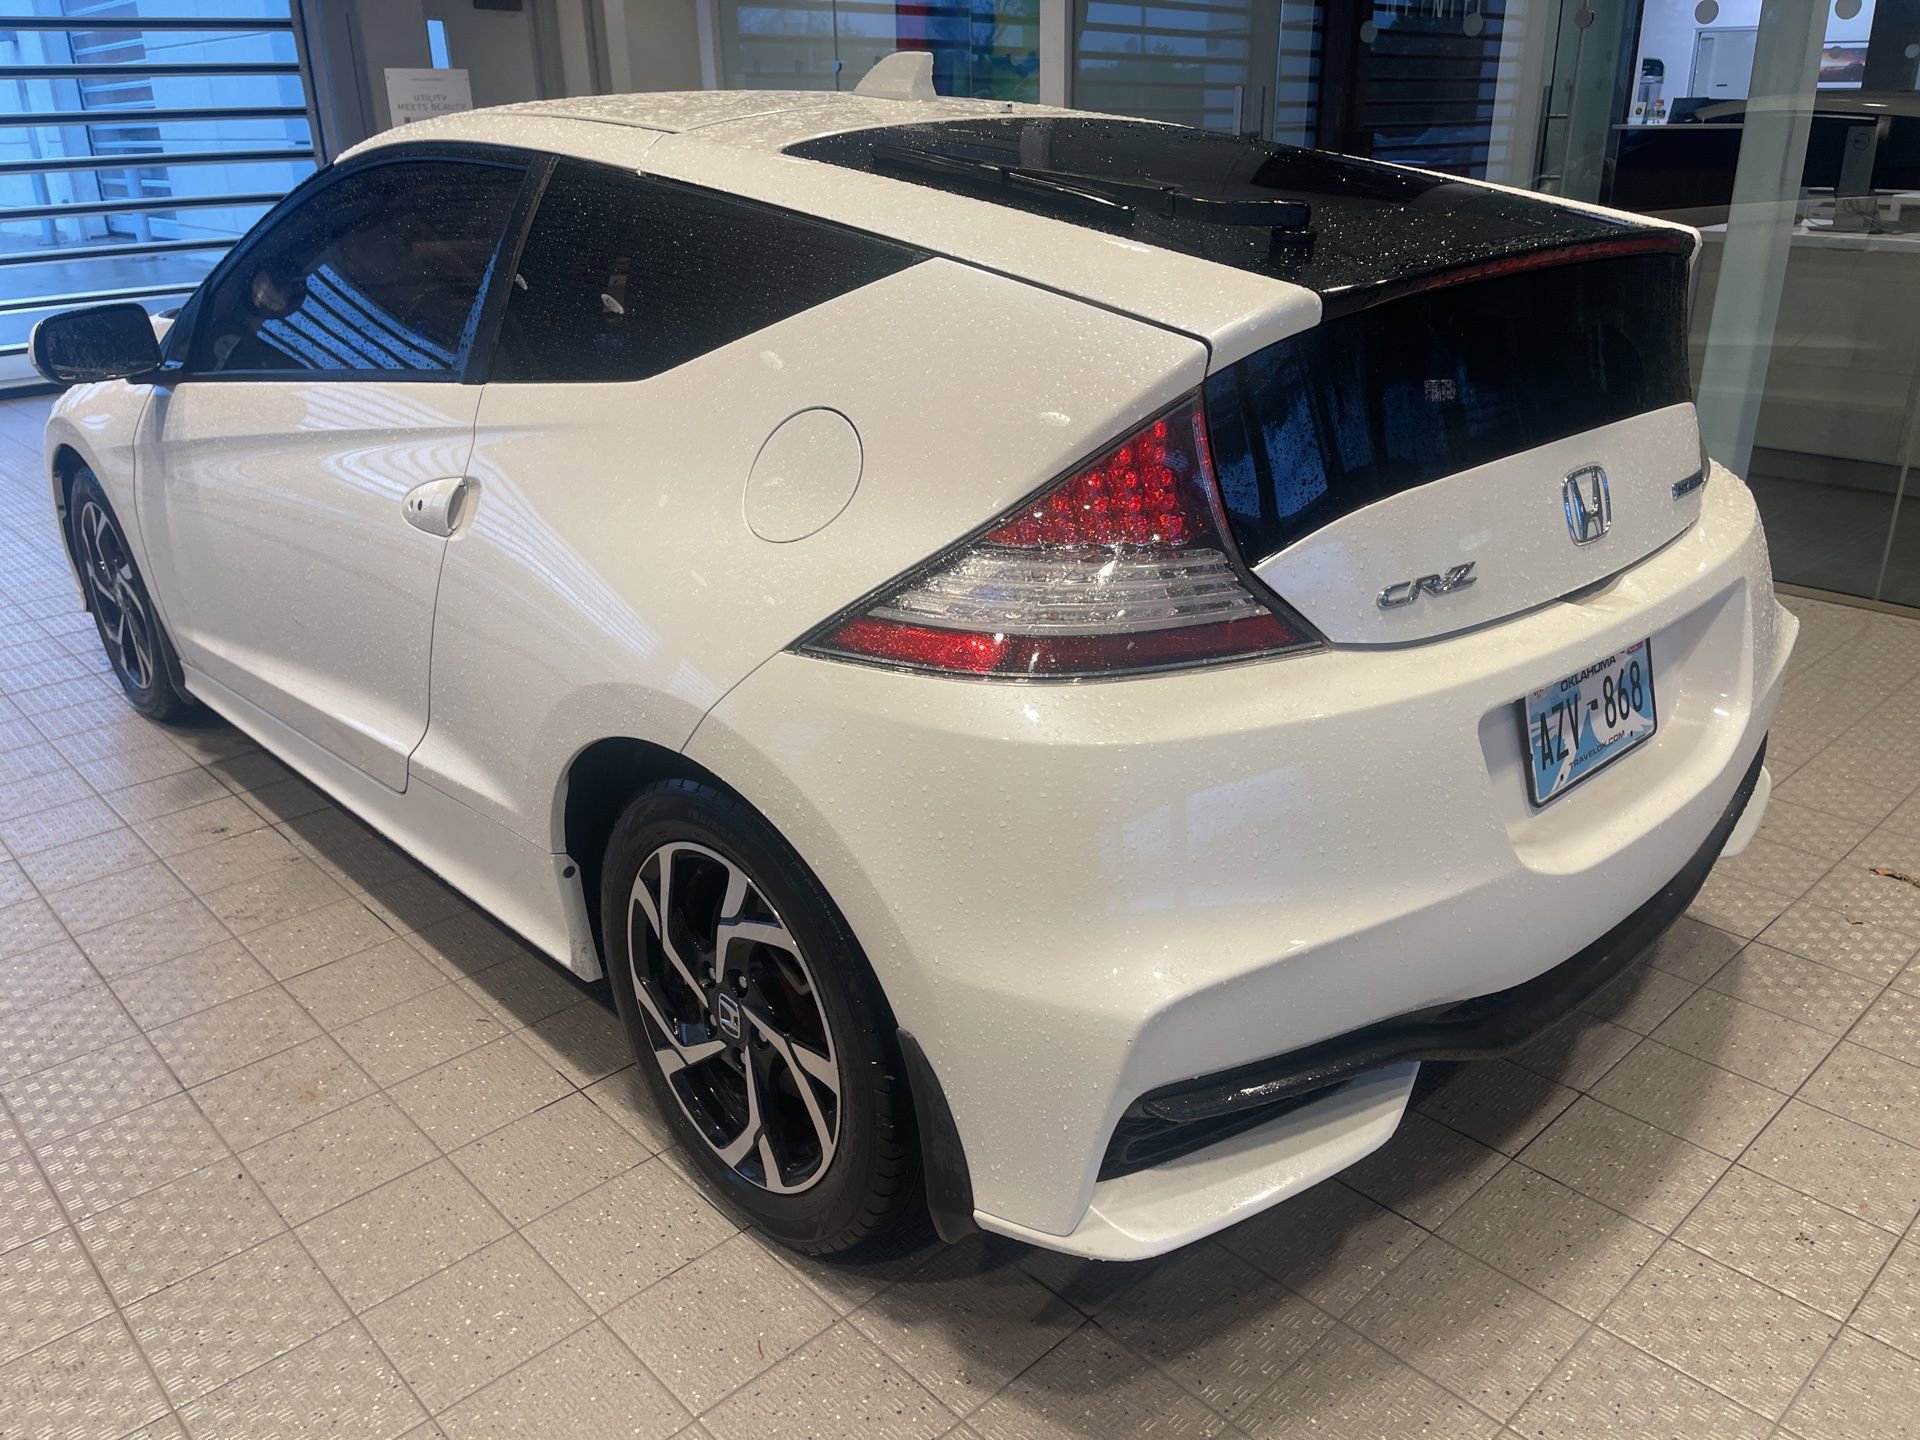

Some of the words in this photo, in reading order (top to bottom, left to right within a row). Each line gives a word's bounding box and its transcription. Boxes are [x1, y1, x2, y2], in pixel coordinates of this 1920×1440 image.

[397, 103, 428, 111] MEETS
[411, 94, 448, 102] UTILITY
[1560, 655, 1616, 693] OKLAHOMA
[1568, 730, 1626, 769] TRAVELOK.COM
